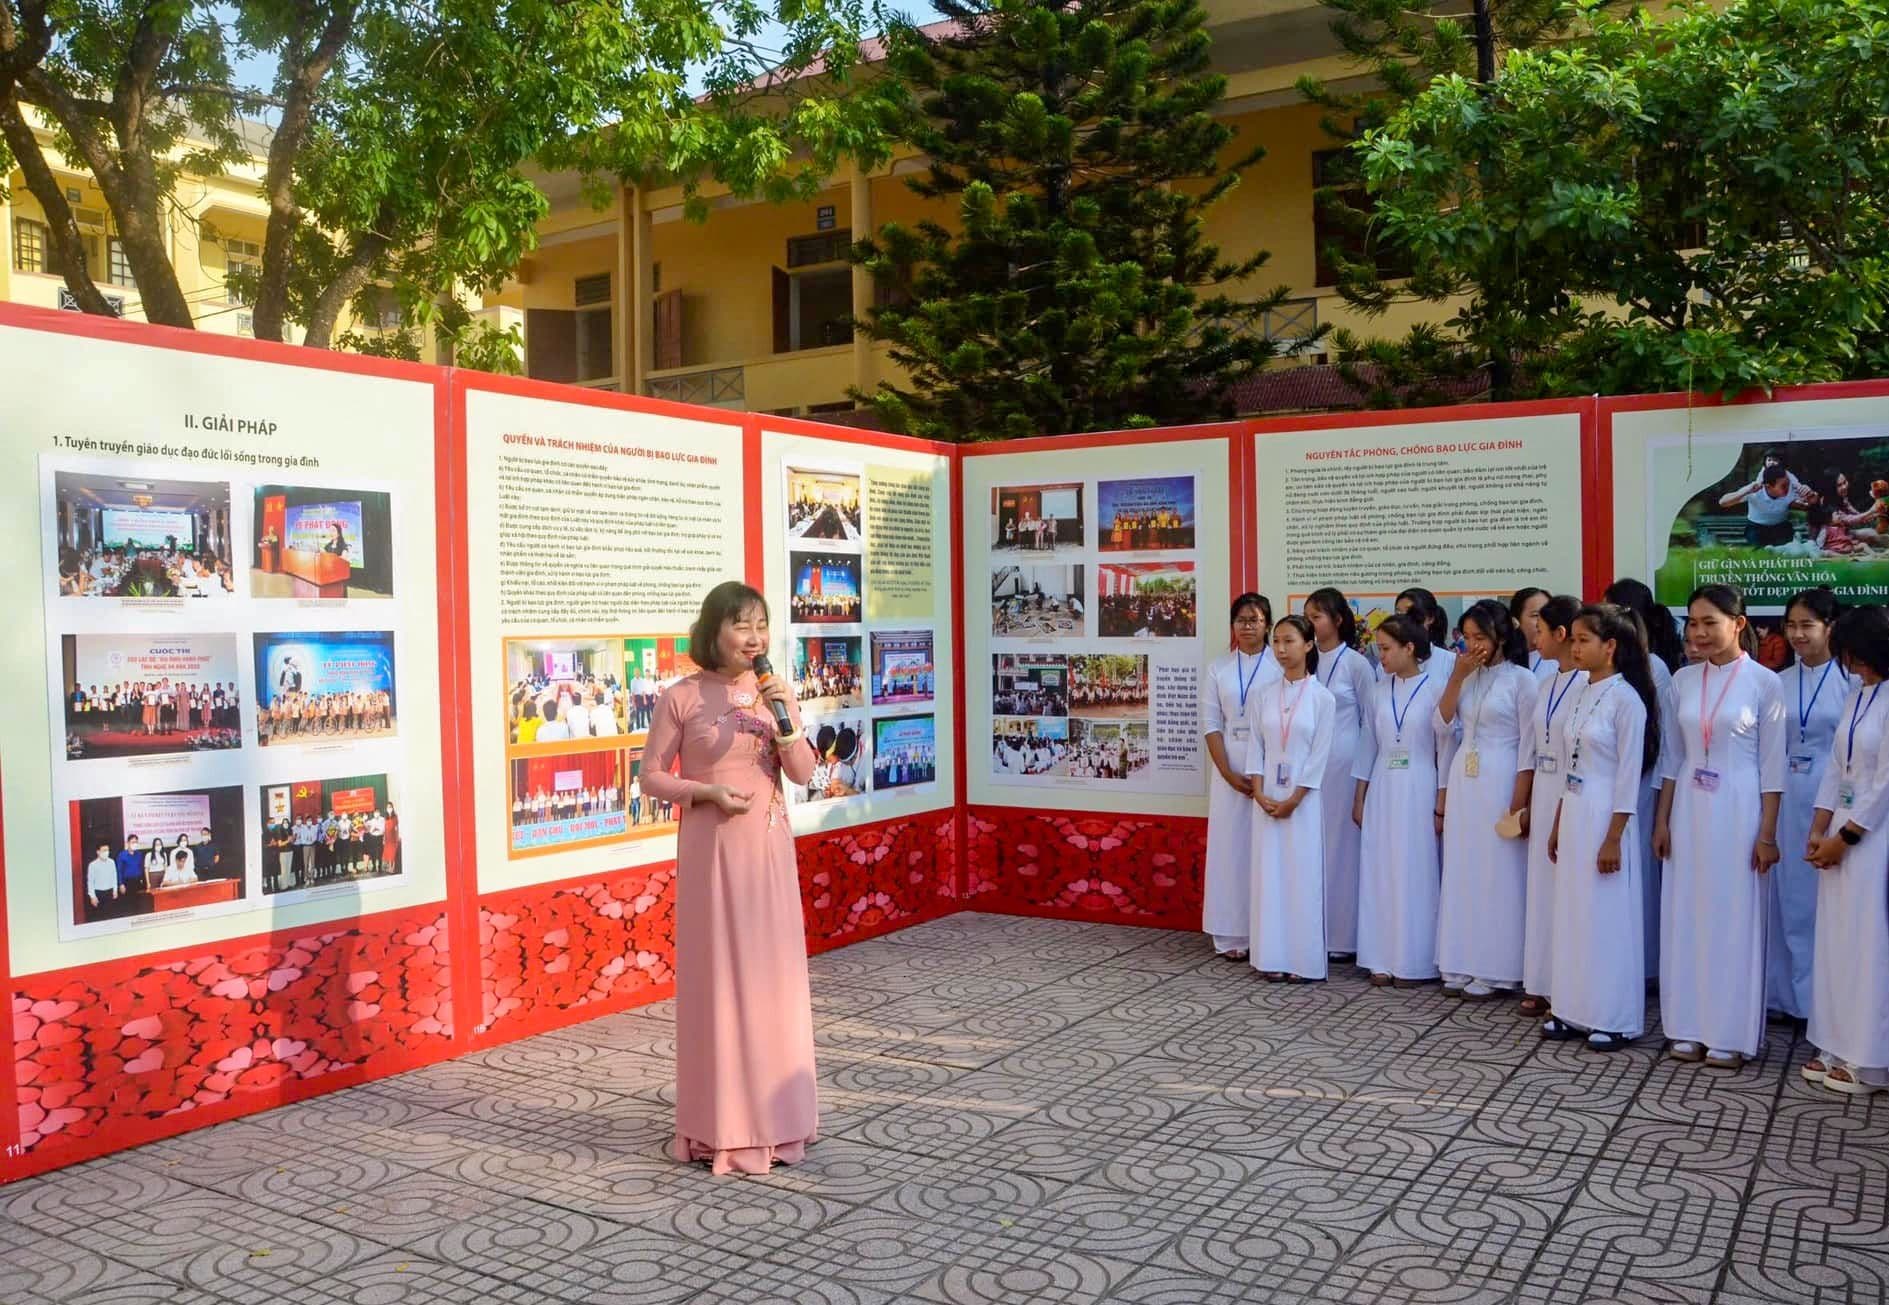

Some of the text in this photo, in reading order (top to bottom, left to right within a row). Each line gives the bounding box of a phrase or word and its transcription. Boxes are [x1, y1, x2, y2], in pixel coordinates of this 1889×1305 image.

[184, 413, 278, 437] II. GIẢI PHÁP
[53, 435, 320, 468] 1. Tuyên truyền giáo dục đạo đức lối sống trong gia đình
[502, 432, 533, 446] QUYỀN
[534, 435, 546, 447] VÀ
[547, 437, 574, 450] TRÁCH
[575, 441, 602, 454] NHIỆM
[603, 442, 619, 455] CỦA
[620, 446, 646, 458] NGƯỜI
[672, 451, 686, 463] LỰC
[686, 454, 699, 464] GIA
[1305, 438, 1523, 461] NGUYÊN TẮC PHÒNG, CHỐNG BẠO LỰC GIA ĐÌNH
[1699, 557, 1814, 570] GIỮ GÌN VÀ PHÁT HUY
[1699, 569, 1742, 583] TRUYỀN
[1744, 568, 1785, 582] THỐNG
[1788, 570, 1811, 582] VĂN
[1743, 583, 1765, 597] TỐT
[1767, 586, 1790, 599] ĐẸP
[1833, 585, 1856, 596] GIA
[1857, 583, 1888, 596] ĐÌNH
[5, 1144, 21, 1158] 11
